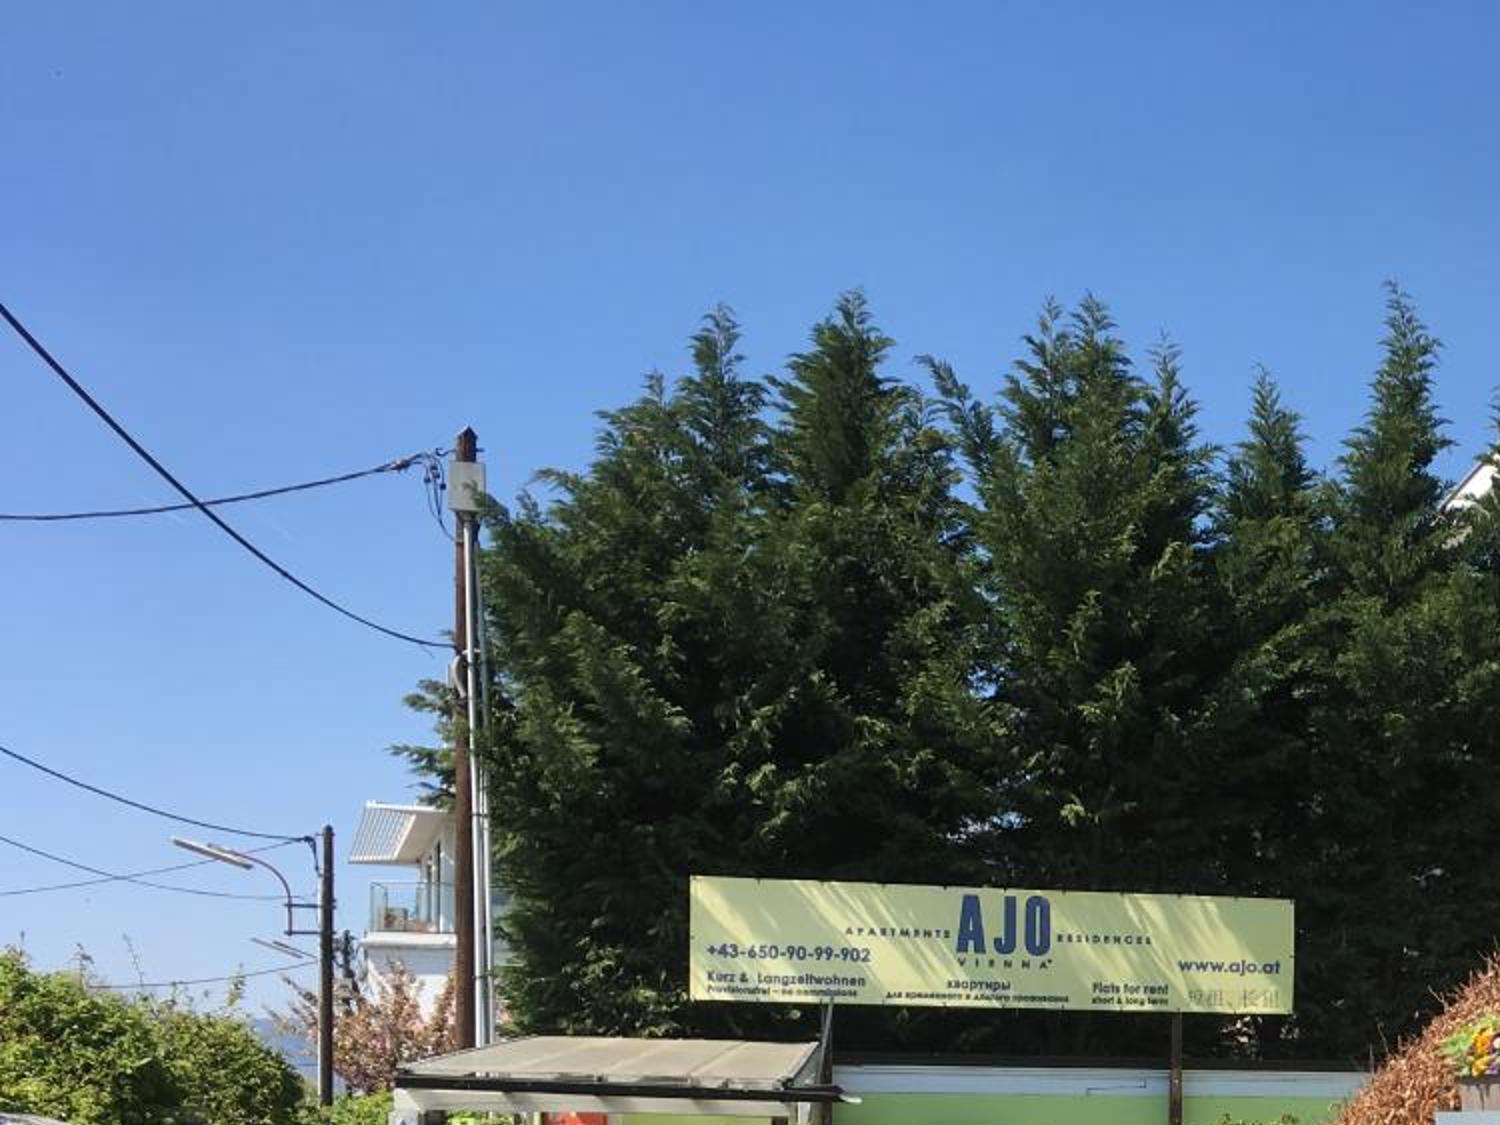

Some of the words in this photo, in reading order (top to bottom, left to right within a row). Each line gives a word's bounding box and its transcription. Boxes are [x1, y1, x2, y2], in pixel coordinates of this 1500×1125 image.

[846, 927, 951, 939] APARTMENTS
[956, 895, 1051, 956] AJO
[1056, 934, 1151, 946] RESIDENCES
[706, 943, 871, 962] +43-650-90-99-902
[1178, 960, 1281, 976] www.ajo.at
[707, 971, 736, 983] Kurz
[757, 972, 866, 987] Langzeitwohnen
